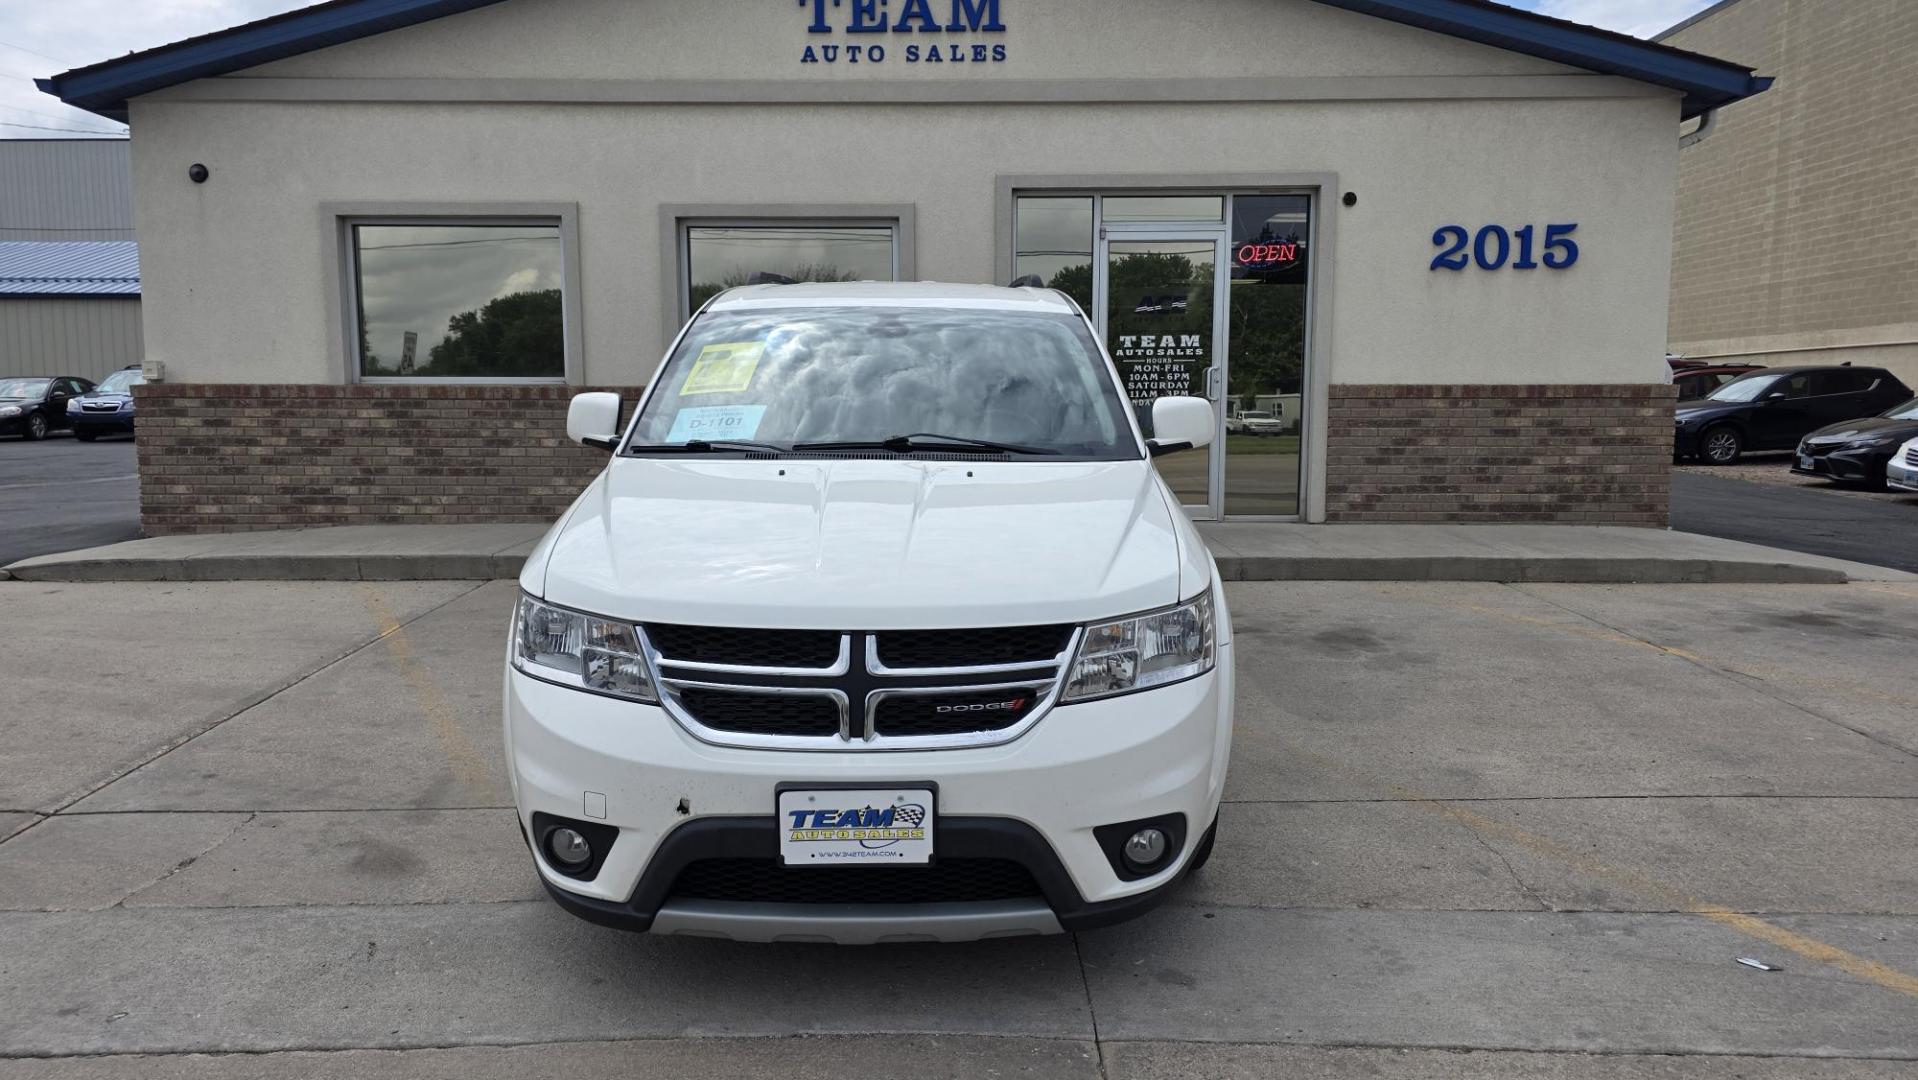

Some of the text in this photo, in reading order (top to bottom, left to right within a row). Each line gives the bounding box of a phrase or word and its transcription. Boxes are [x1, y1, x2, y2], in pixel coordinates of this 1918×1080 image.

[799, 0, 1006, 33] TEAM
[801, 45, 1006, 63] AUTO SALES
[1239, 245, 1296, 262] OPEN
[1430, 224, 1579, 271] 2015
[1119, 335, 1200, 347] TEAM
[1129, 373, 1158, 381] 10AM
[1130, 390, 1158, 398] 11AM
[689, 417, 743, 429] D-1101
[936, 701, 1015, 713] DODGE
[788, 808, 896, 828] TEAM
[791, 828, 924, 840] AUTO SALES
